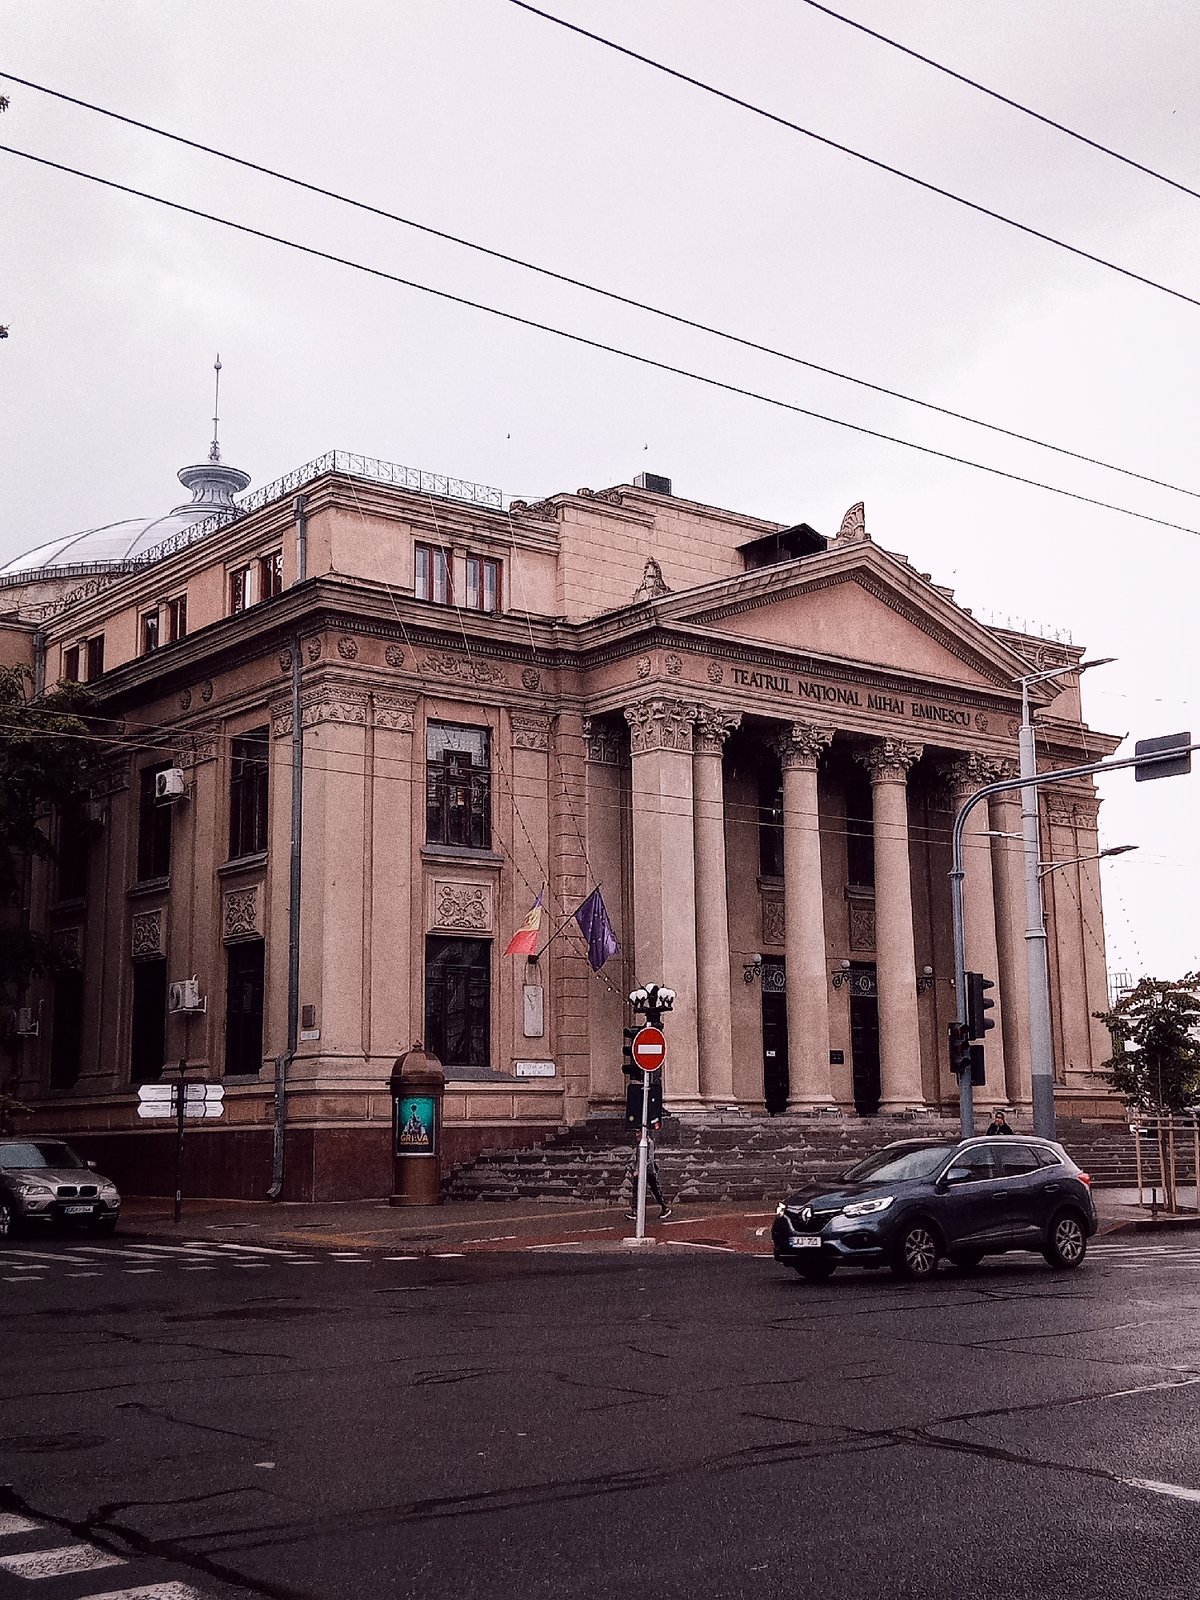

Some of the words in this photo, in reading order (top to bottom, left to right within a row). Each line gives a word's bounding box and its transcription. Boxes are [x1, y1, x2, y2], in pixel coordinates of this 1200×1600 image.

[731, 668, 793, 693] TEATRUL
[867, 693, 904, 714] MIHAI
[911, 702, 971, 726] EMINESCU
